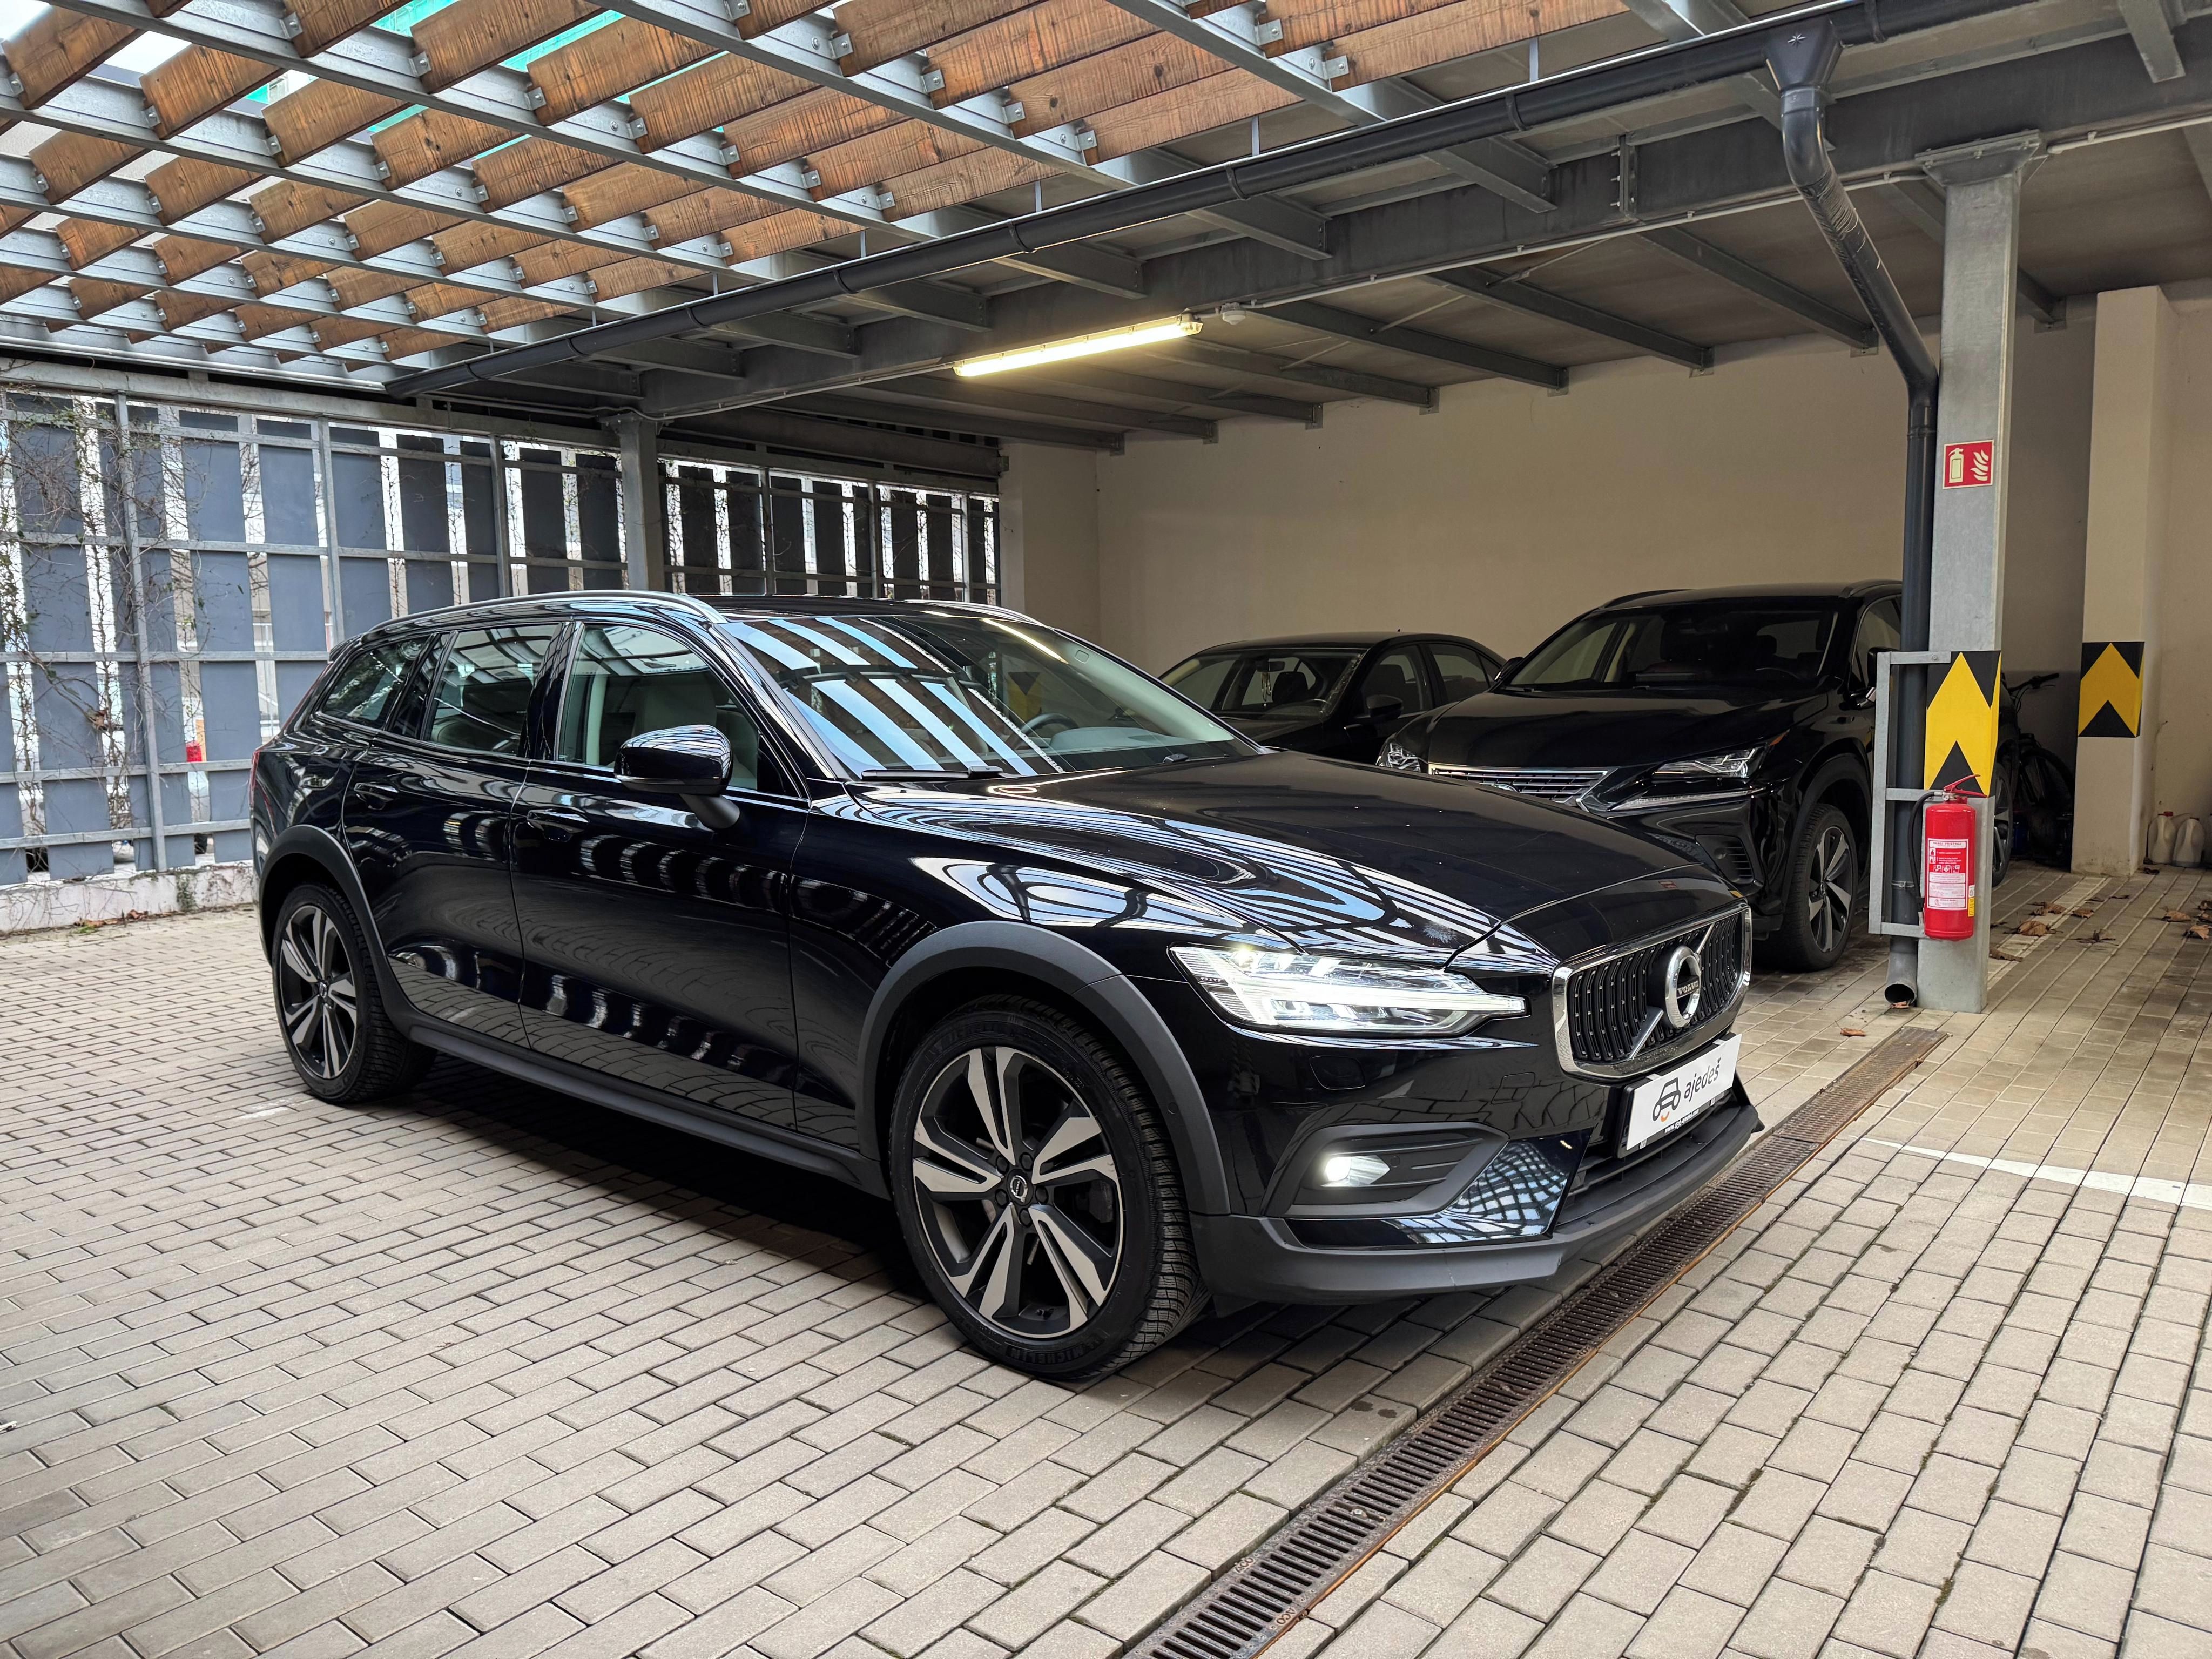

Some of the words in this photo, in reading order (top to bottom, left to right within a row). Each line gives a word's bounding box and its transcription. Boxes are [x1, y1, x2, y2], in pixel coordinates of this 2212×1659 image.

[1677, 980, 1699, 995] VOLVO
[1684, 1057, 1722, 1102] ajedeš
[1009, 1345, 1085, 1365] MICHELIN
[1235, 1557, 1254, 1573] ACO
[1276, 1607, 1296, 1624] ACO
